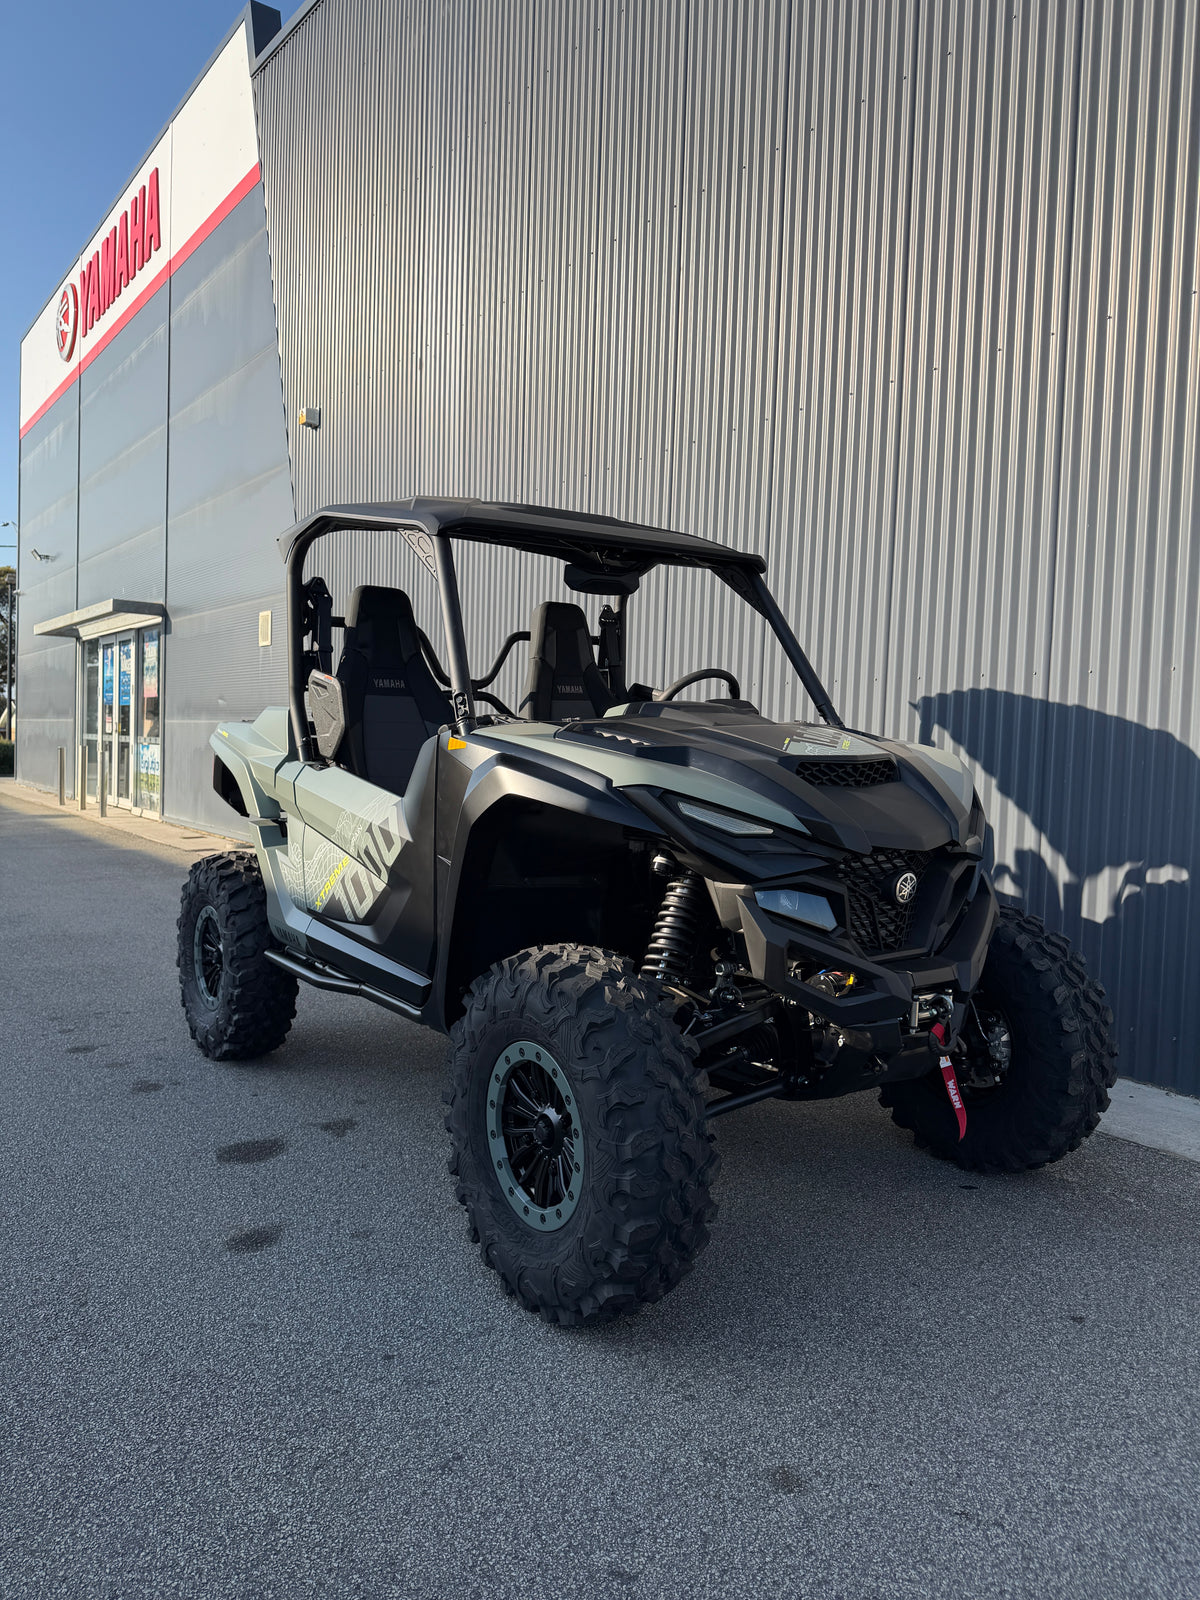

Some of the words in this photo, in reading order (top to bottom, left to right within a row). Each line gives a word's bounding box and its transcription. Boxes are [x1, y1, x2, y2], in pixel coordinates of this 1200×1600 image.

[80, 167, 161, 338] YAMAHA
[373, 678, 406, 689] YAMAHA
[556, 684, 584, 694] YAMAHA
[315, 855, 350, 910] XTREME
[333, 805, 402, 922] 1000
[947, 1079, 962, 1109] WARN
